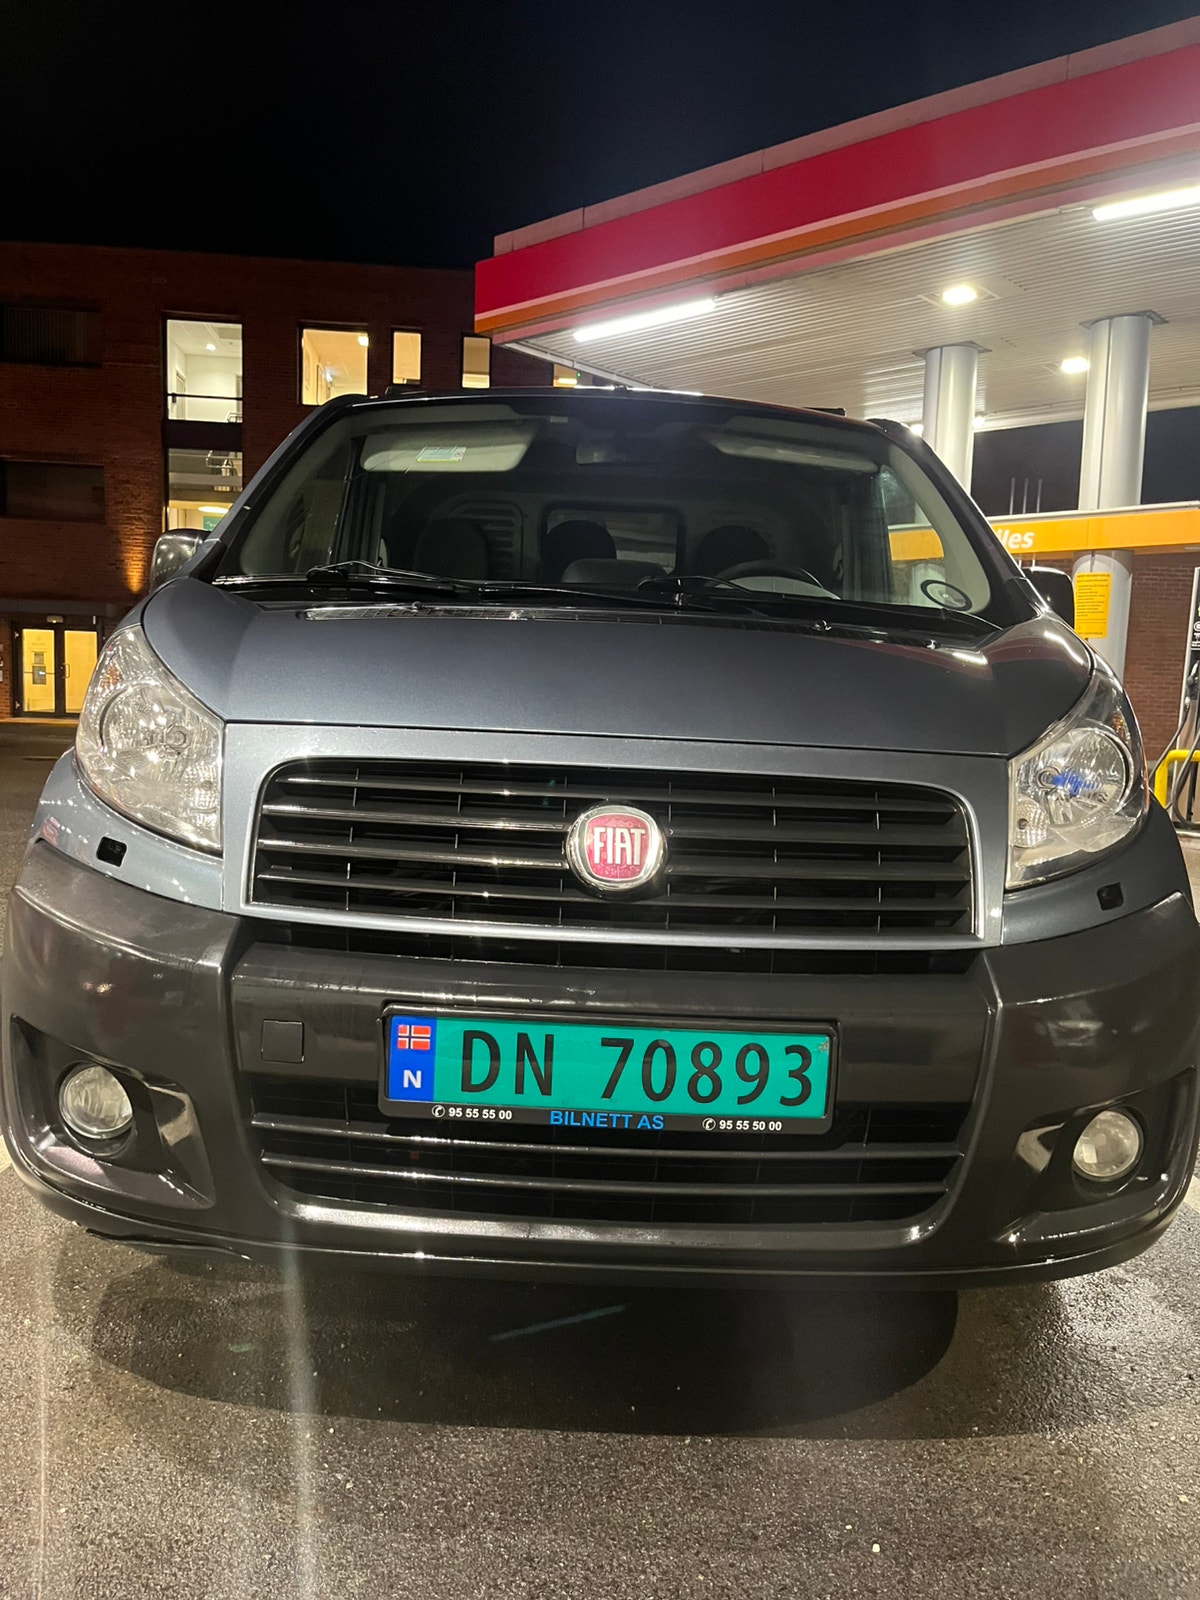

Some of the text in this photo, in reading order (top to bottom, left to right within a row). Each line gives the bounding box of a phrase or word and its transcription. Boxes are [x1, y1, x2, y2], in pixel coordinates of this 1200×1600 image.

[593, 827, 646, 866] FIAT
[461, 1030, 813, 1107] DN 70893
[403, 1069, 421, 1089] N
[448, 1107, 513, 1120] 95 55 55 00
[550, 1110, 664, 1130] BILNETT AS
[719, 1119, 782, 1131] 95 55 50 00
